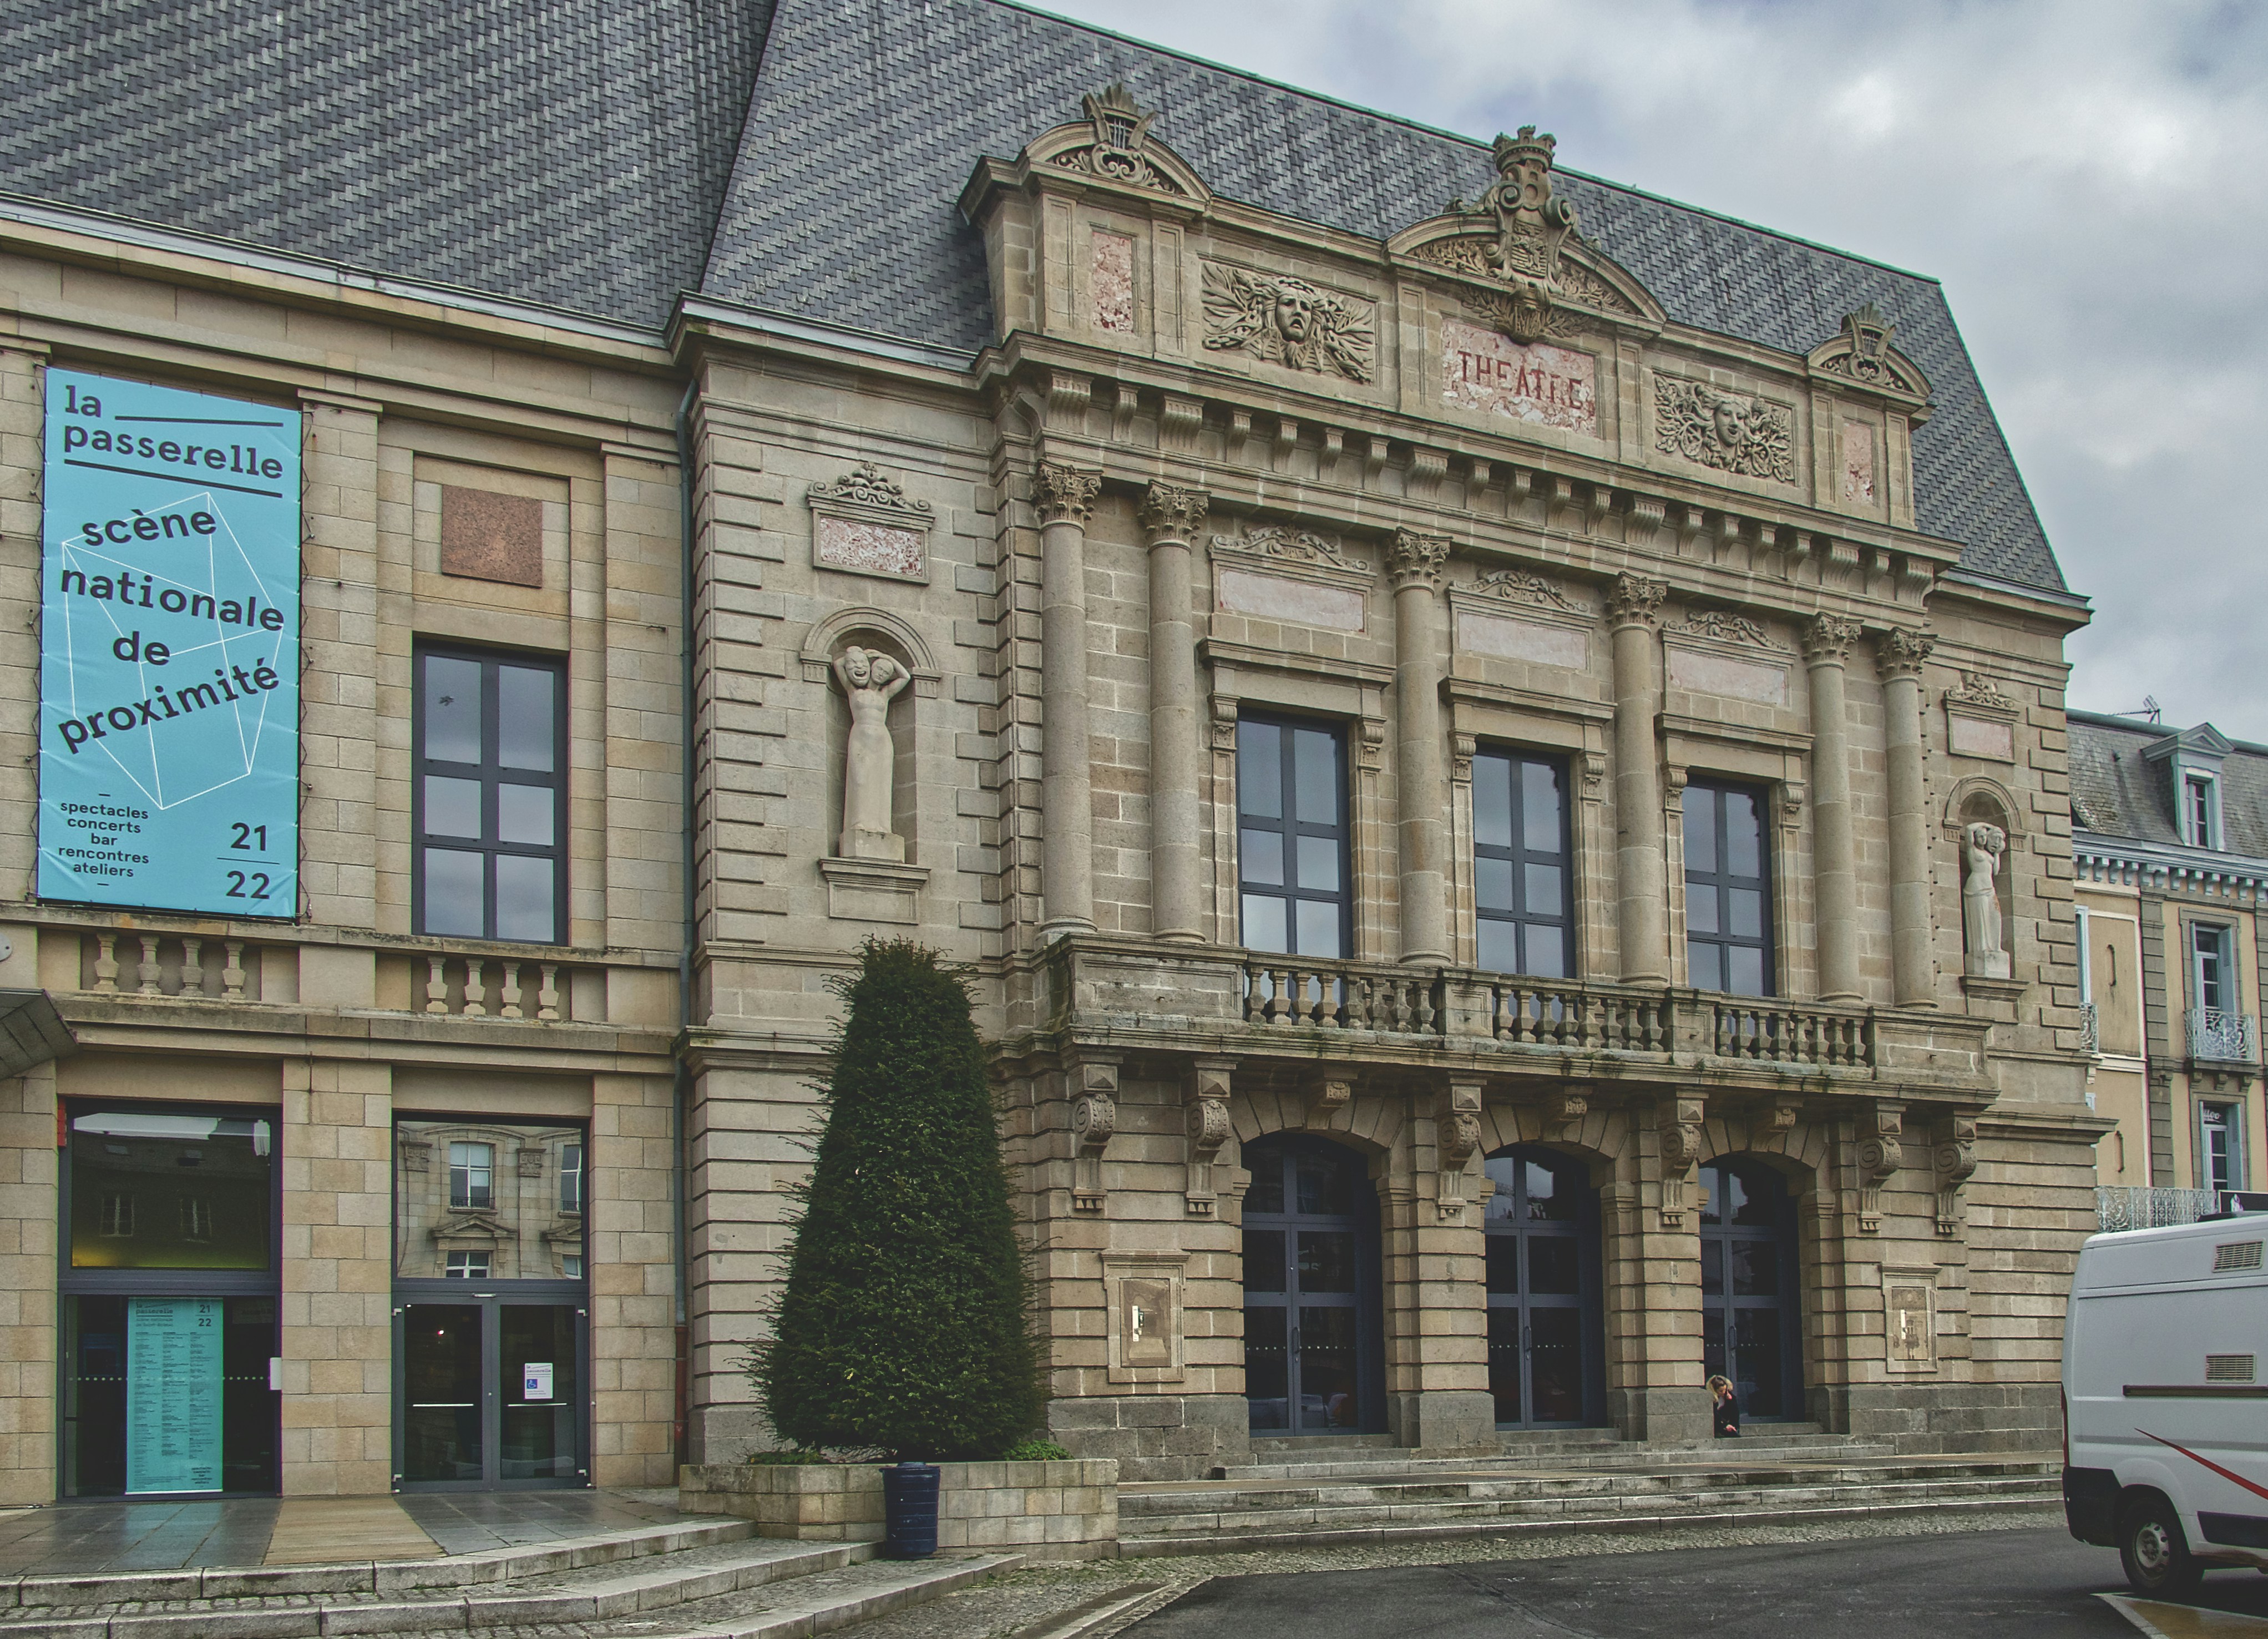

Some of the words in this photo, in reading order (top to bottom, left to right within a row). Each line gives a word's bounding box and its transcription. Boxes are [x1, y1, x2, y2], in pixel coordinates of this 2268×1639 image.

[65, 385, 102, 418] la
[64, 426, 283, 479] passerelle
[82, 509, 217, 547] scène
[61, 570, 285, 631] nationale
[113, 631, 170, 666] de
[58, 657, 280, 755] proximité
[60, 802, 149, 820] spectacles
[67, 818, 141, 833] concerts
[91, 833, 118, 846] bar
[231, 822, 267, 851] 21
[59, 847, 149, 864] rencontres
[73, 862, 134, 877] ateliers
[226, 871, 270, 899] 22
[198, 1318, 212, 1327] 22
[199, 1304, 211, 1313] 21
